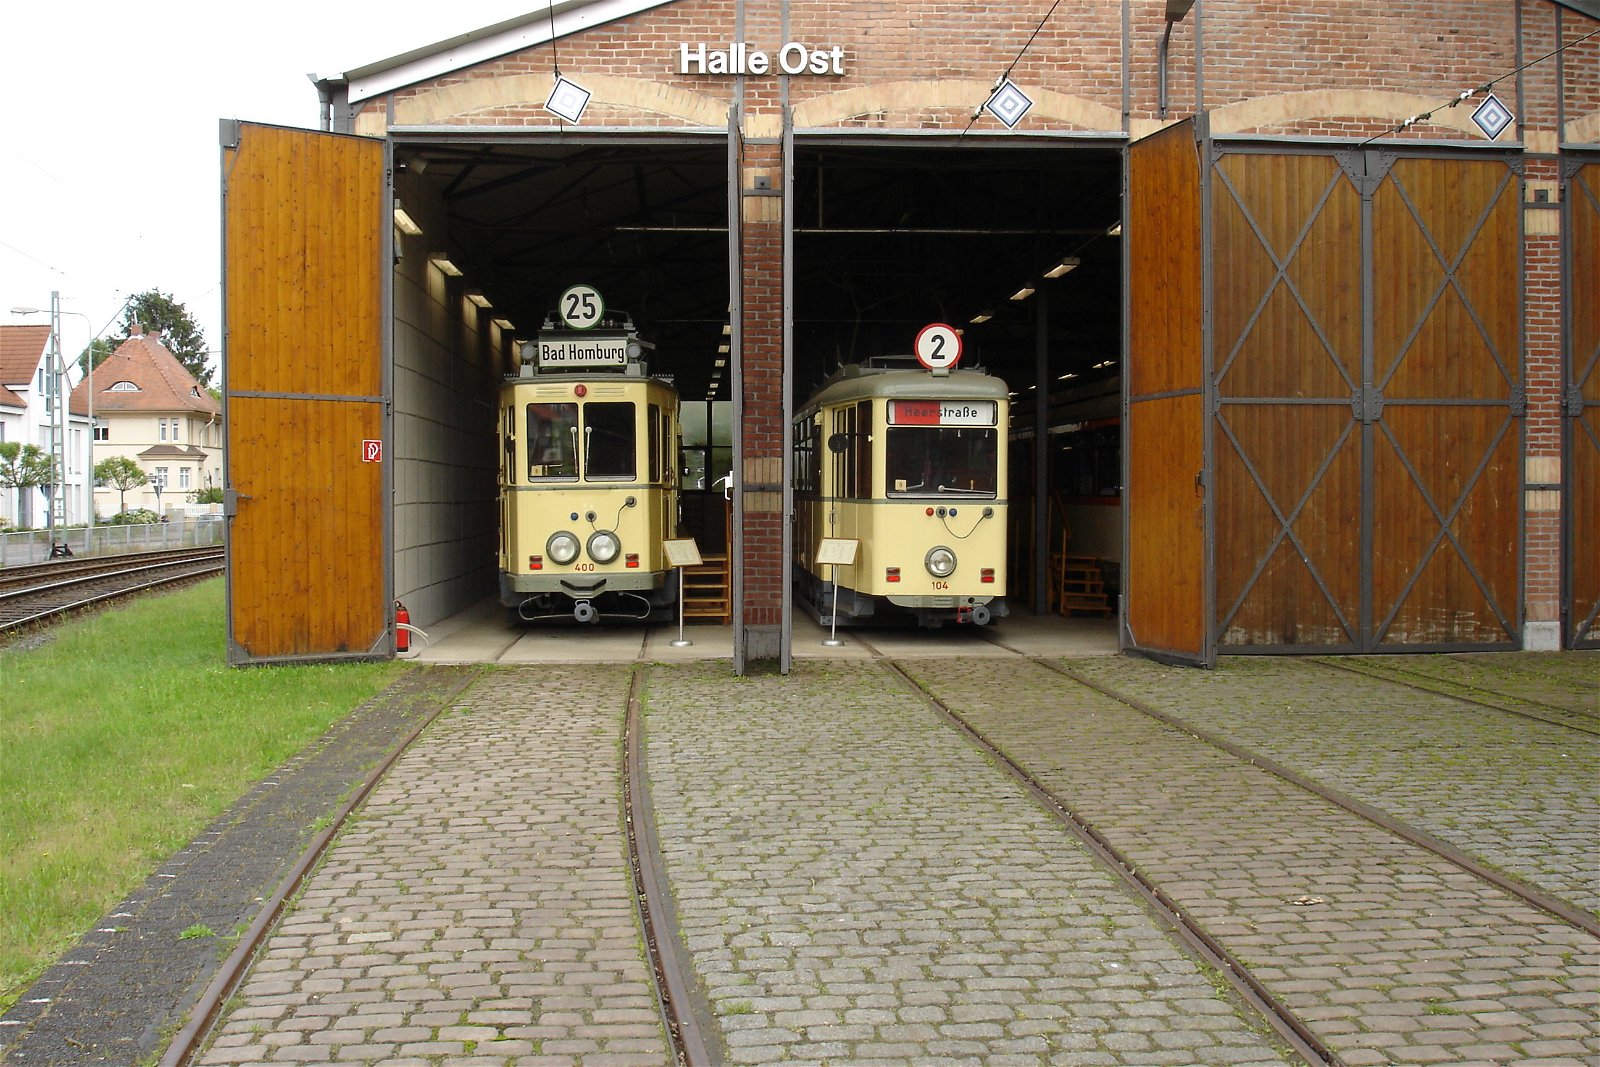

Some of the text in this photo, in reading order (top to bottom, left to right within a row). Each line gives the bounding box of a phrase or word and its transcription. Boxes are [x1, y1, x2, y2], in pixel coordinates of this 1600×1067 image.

[680, 42, 844, 75] Halle Ost
[566, 293, 596, 320] 25
[542, 344, 625, 363] Bad Homburg
[931, 334, 946, 360] 2
[905, 406, 978, 418] Heerstraße
[575, 563, 595, 572] 400
[931, 581, 949, 590] 104
